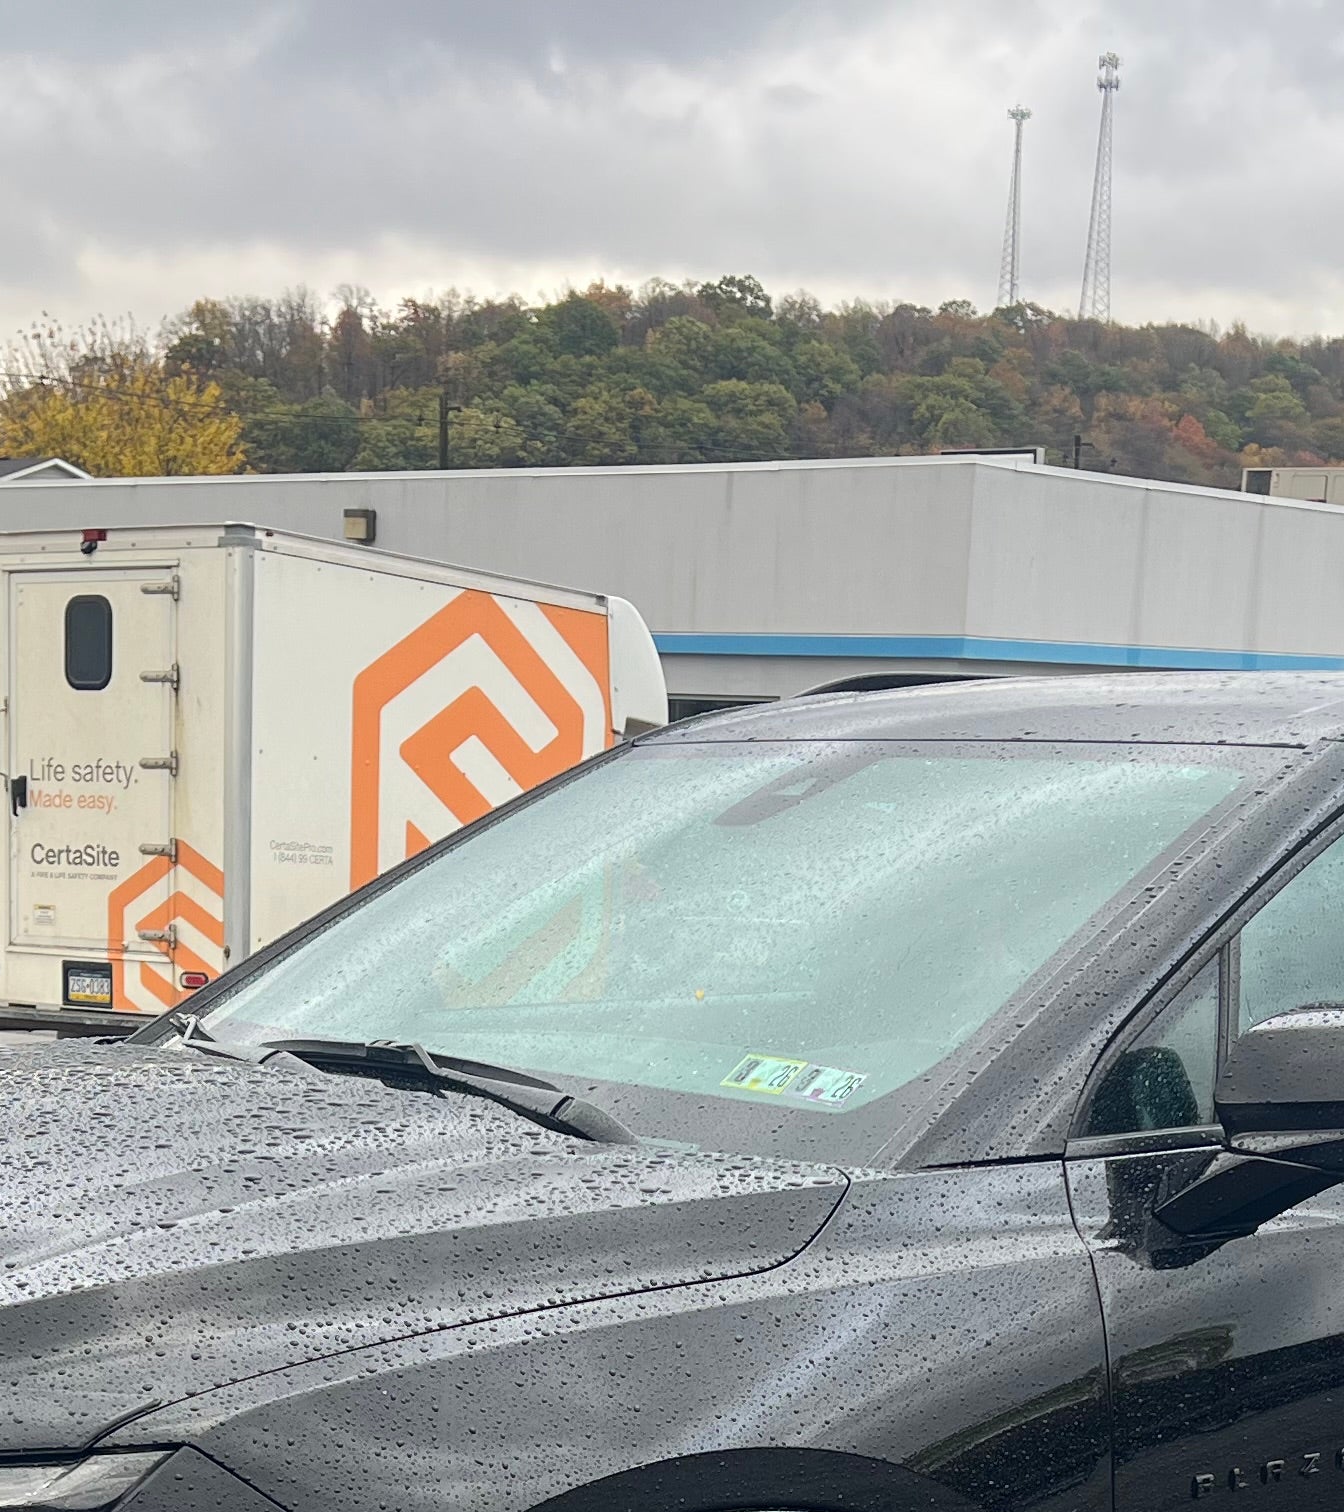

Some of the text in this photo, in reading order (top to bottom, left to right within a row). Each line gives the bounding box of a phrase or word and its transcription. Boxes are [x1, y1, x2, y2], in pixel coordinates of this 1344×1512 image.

[30, 757, 138, 790] Life safety.
[29, 789, 118, 815] Made easy.
[31, 842, 120, 867] CertaSite
[768, 1064, 800, 1088] 26
[831, 1074, 862, 1099] 26
